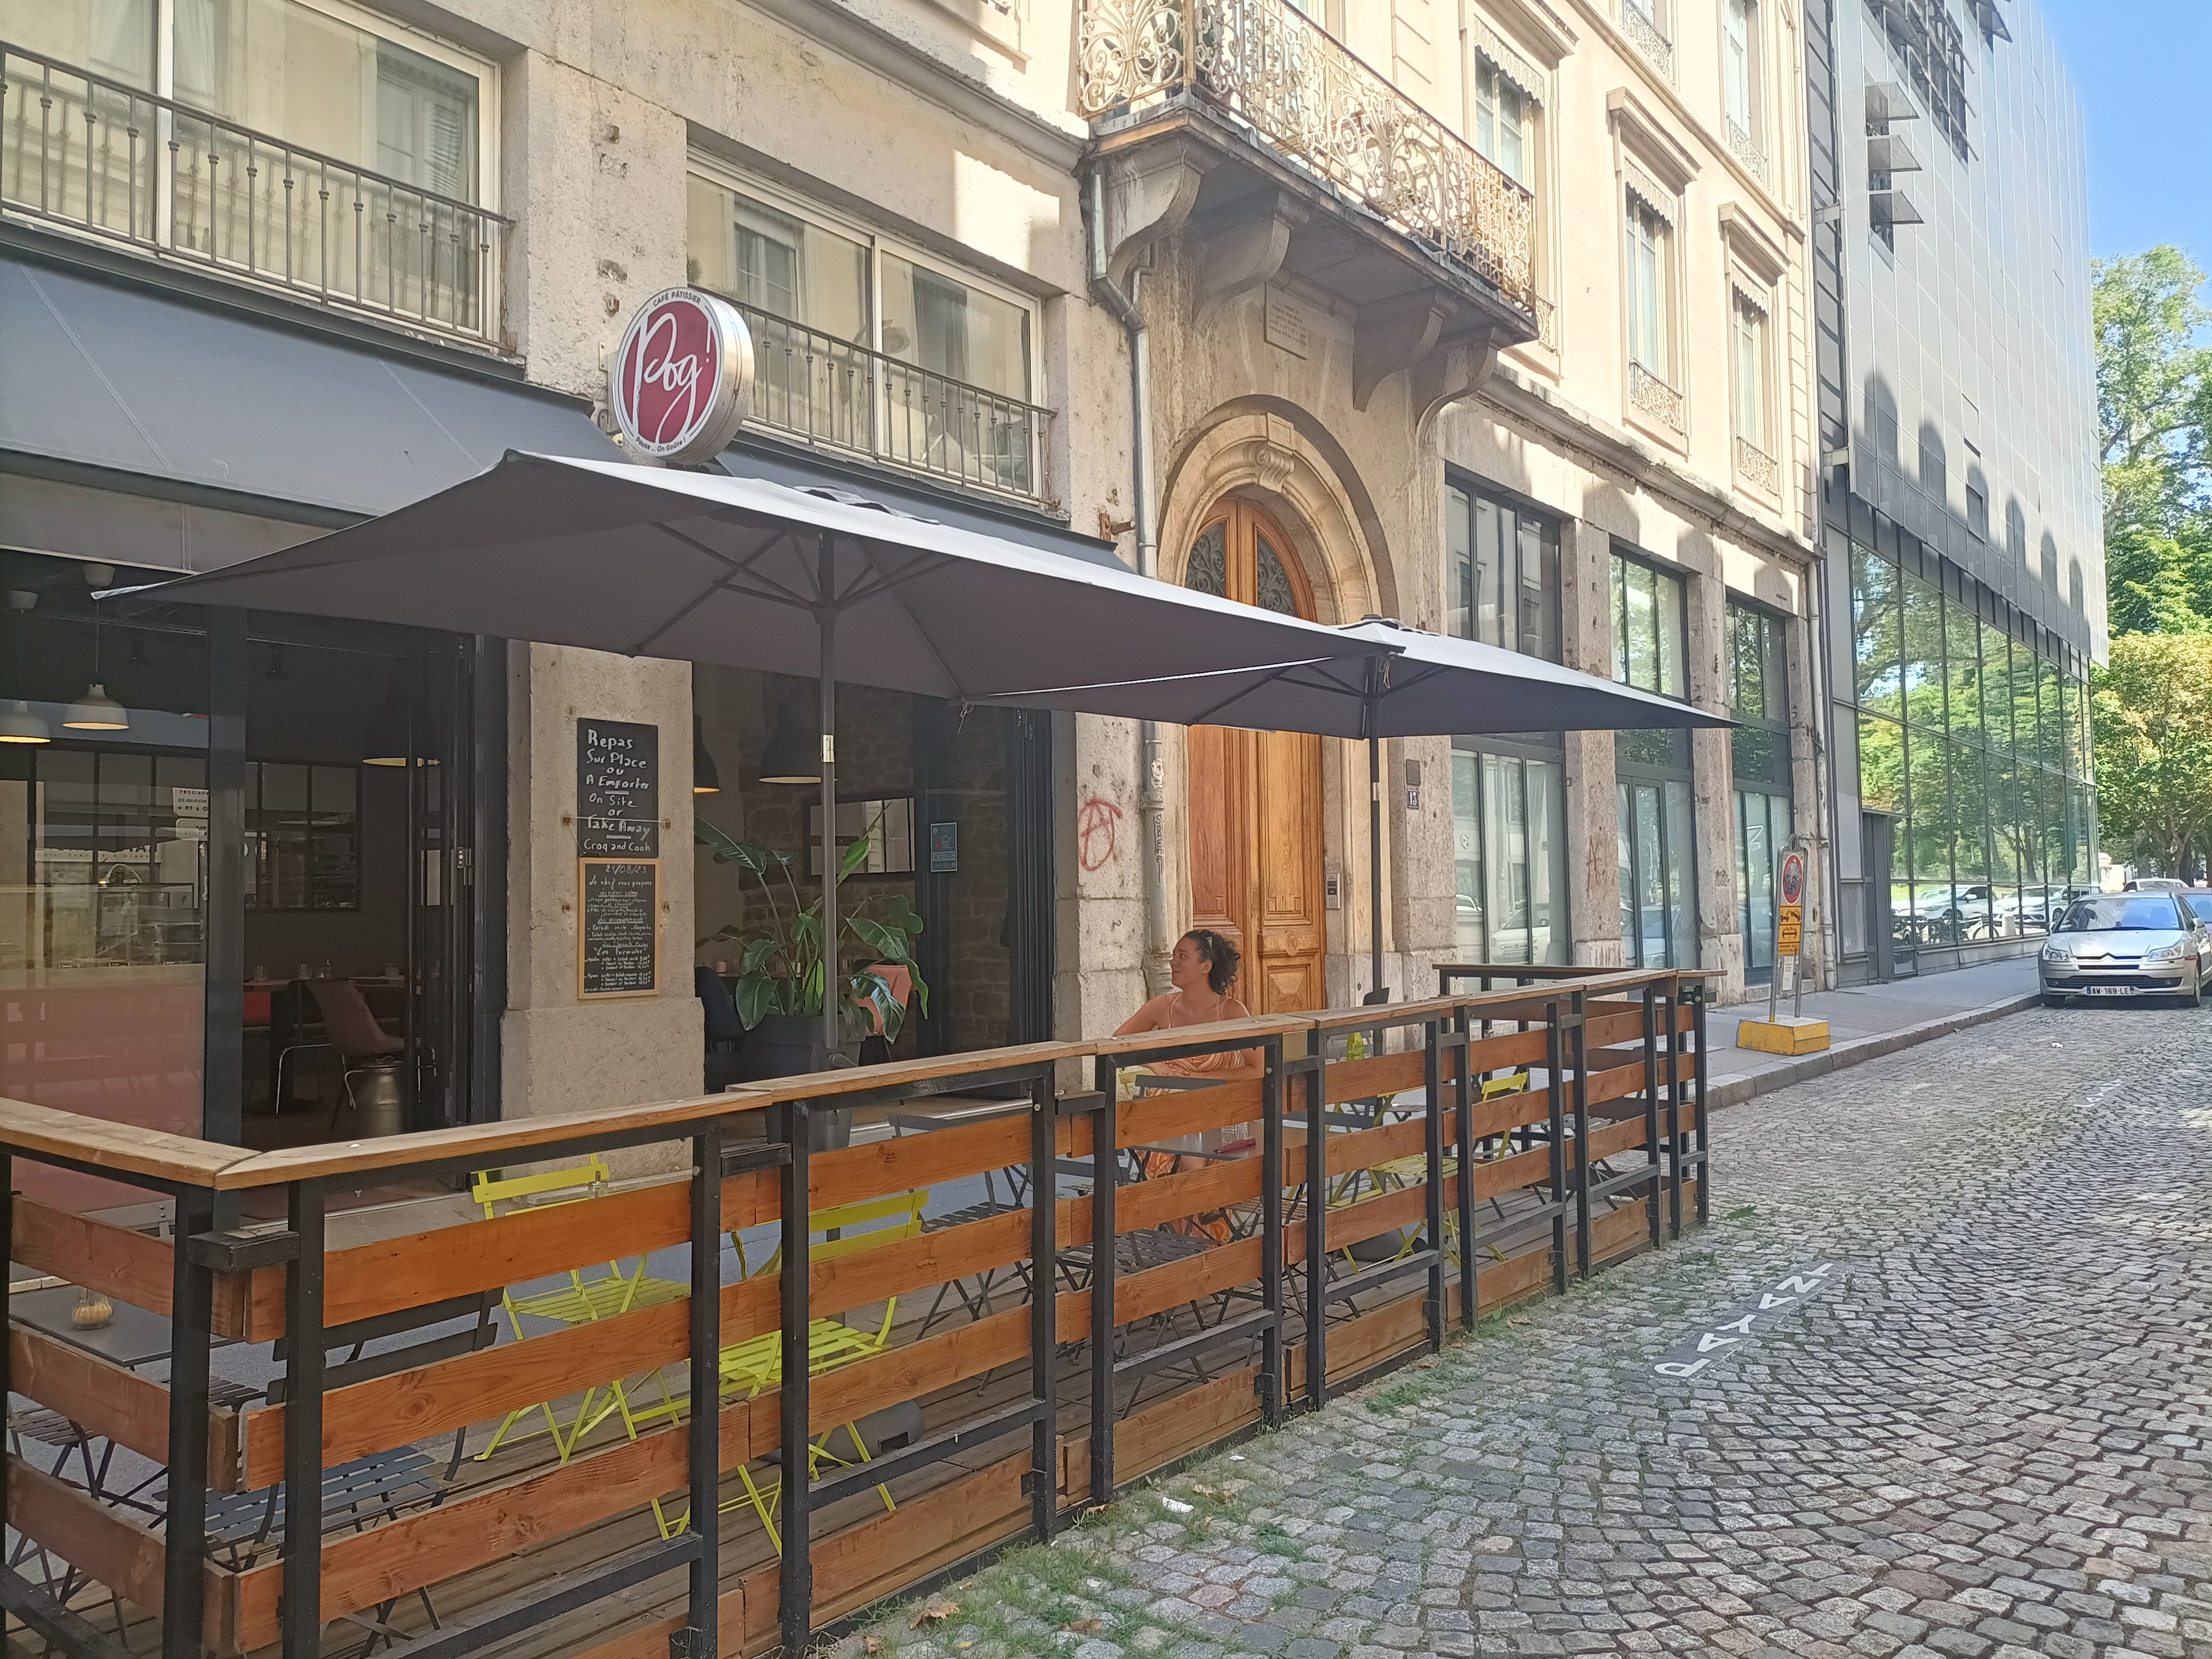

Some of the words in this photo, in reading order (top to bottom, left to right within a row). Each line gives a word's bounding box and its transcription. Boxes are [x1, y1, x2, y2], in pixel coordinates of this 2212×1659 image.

[653, 291, 669, 307] CAFÉ
[671, 289, 701, 305] PÂTISSIER
[635, 436, 650, 450] Pause
[588, 729, 633, 750] Repas
[586, 748, 606, 764] Sur
[610, 752, 647, 768] Place
[607, 767, 624, 775] ou
[586, 774, 594, 785] A
[598, 775, 650, 789] Emporter
[589, 793, 603, 804] On
[609, 795, 638, 807] Site
[1410, 791, 1417, 806] 13
[587, 814, 615, 831] Take
[618, 821, 651, 841] Away
[584, 838, 608, 852] Croq
[611, 842, 626, 850] and
[629, 842, 651, 852] Cook
[606, 864, 646, 875] 21/08/23
[601, 877, 615, 890] chef
[1653, 1262, 1834, 1378] PAYANT
